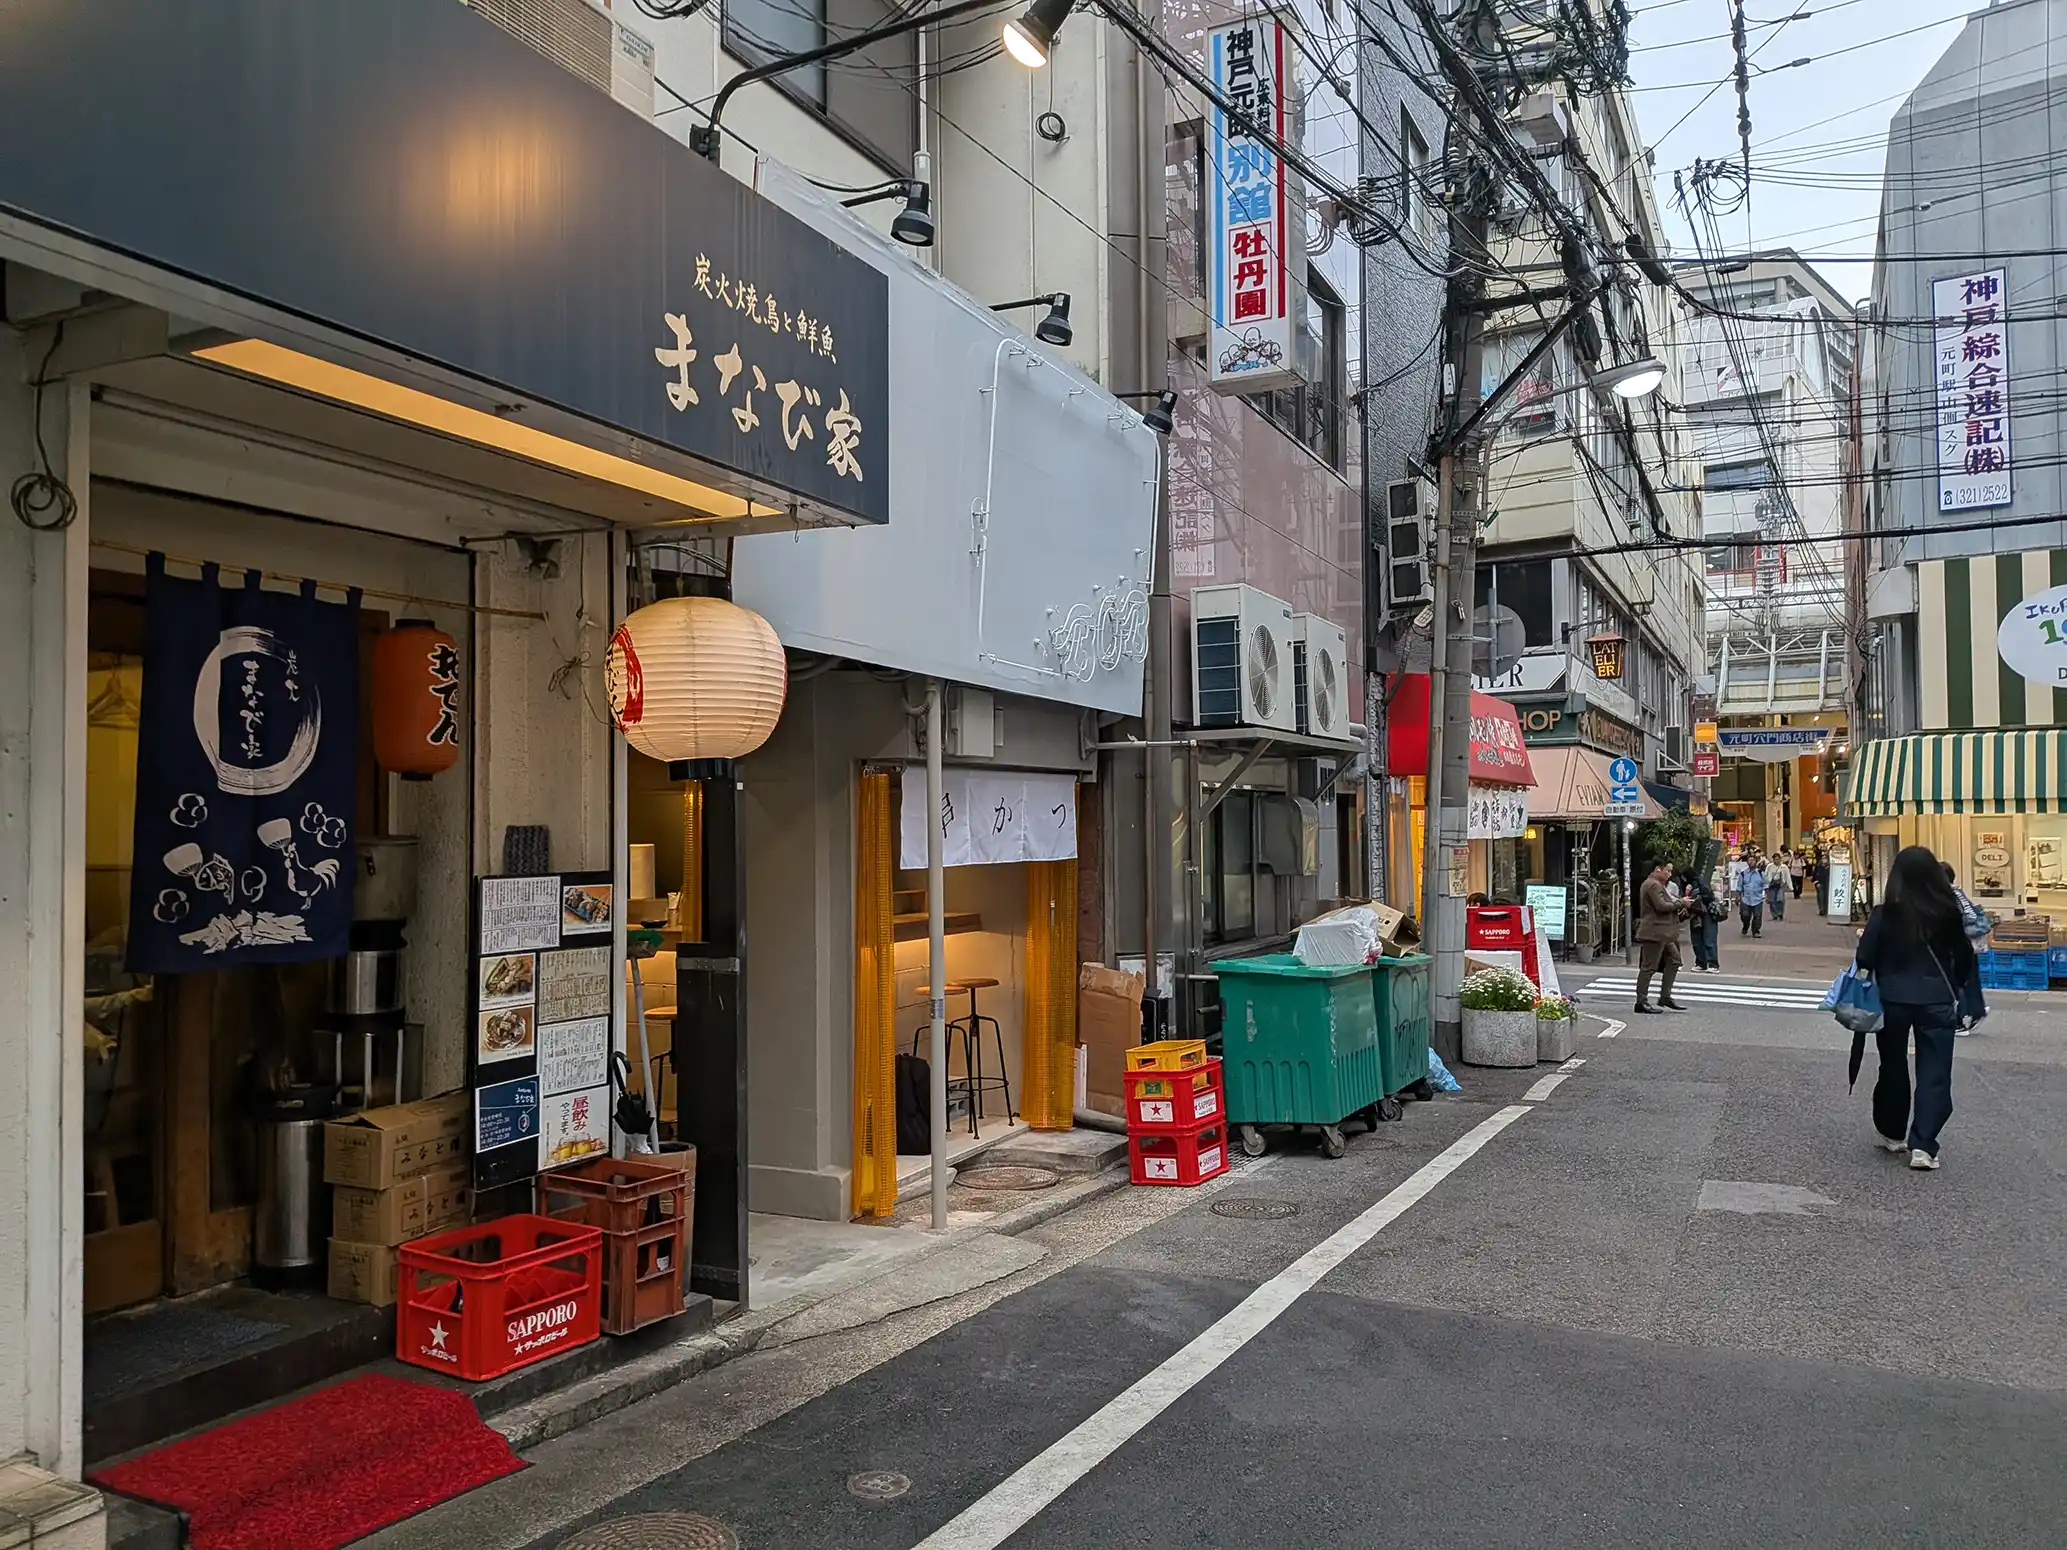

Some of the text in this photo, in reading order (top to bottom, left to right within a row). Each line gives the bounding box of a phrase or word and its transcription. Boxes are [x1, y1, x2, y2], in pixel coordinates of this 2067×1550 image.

[1232, 228, 1268, 320] 牡丹園
[692, 252, 837, 364] 炭火焼鳥と鮮魚
[655, 312, 863, 482] まなび家
[1595, 654, 1616, 667] ELI
[1598, 665, 1616, 678] ER
[1728, 731, 1819, 746] 元町穴門商店街
[1576, 784, 1605, 807] EVIAN
[1981, 853, 2003, 862] DELI
[1833, 888, 1845, 908] 餃子
[1484, 928, 1511, 936] SAPPORO
[571, 1095, 590, 1132] 昼飲み
[506, 1300, 578, 1343] SAPPORO
